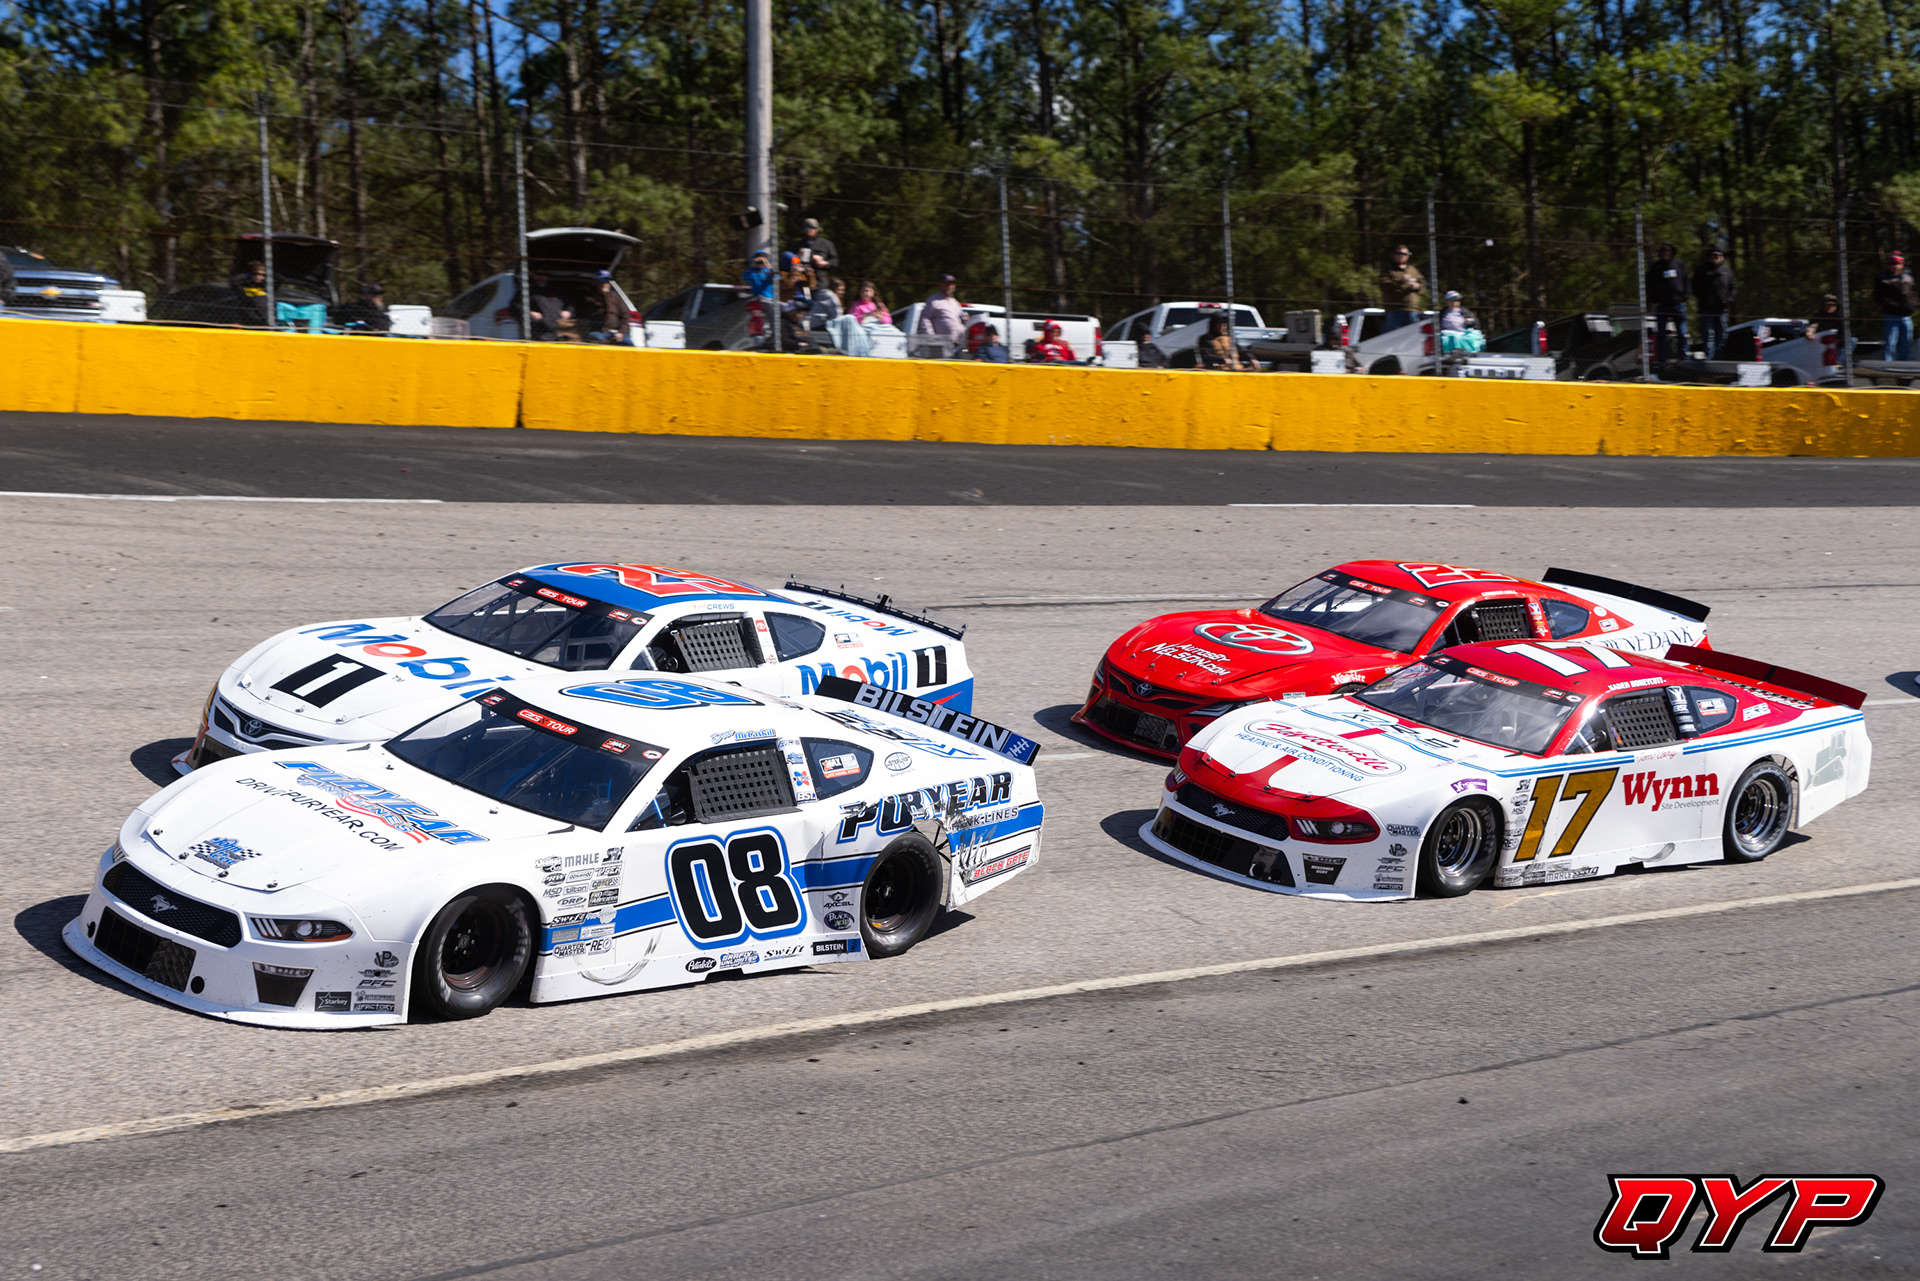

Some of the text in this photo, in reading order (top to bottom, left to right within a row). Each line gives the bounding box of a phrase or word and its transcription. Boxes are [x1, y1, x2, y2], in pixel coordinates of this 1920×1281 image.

[562, 597, 587, 607] TOUR
[1141, 642, 1233, 676] NELSON.COM
[1180, 643, 1233, 662] AUTOSBY
[1495, 642, 1632, 677] 17
[795, 652, 908, 695] Mobil
[1492, 676, 1519, 686] TOUR
[558, 677, 765, 710] 08
[854, 683, 1010, 750] BILSTEIN
[546, 721, 575, 735] TOUR
[1257, 723, 1389, 772] Fayetteville
[1235, 731, 1364, 783] HEATING & AIR CONDITIONING
[1622, 771, 1719, 812] Wynn
[272, 761, 490, 845] PURYEAR
[836, 771, 1014, 844] PURYEAR
[1661, 799, 1719, 811] Site Development
[351, 797, 415, 832] LINES
[985, 807, 1018, 823] LINES
[1512, 768, 1619, 863] 17
[564, 853, 599, 867] MAHLE
[974, 851, 1029, 878] BLACK GATE
[543, 885, 587, 897] MSD tilton
[667, 829, 805, 947] 08
[823, 901, 854, 909] AXCEL
[554, 943, 585, 953] QUARTER
[559, 948, 585, 957] MASTER
[764, 945, 805, 958] Swift
[816, 943, 844, 951] BILSTEIN
[374, 951, 393, 967] VP
[359, 979, 397, 987] PFC
[325, 997, 348, 1006] Starkey
